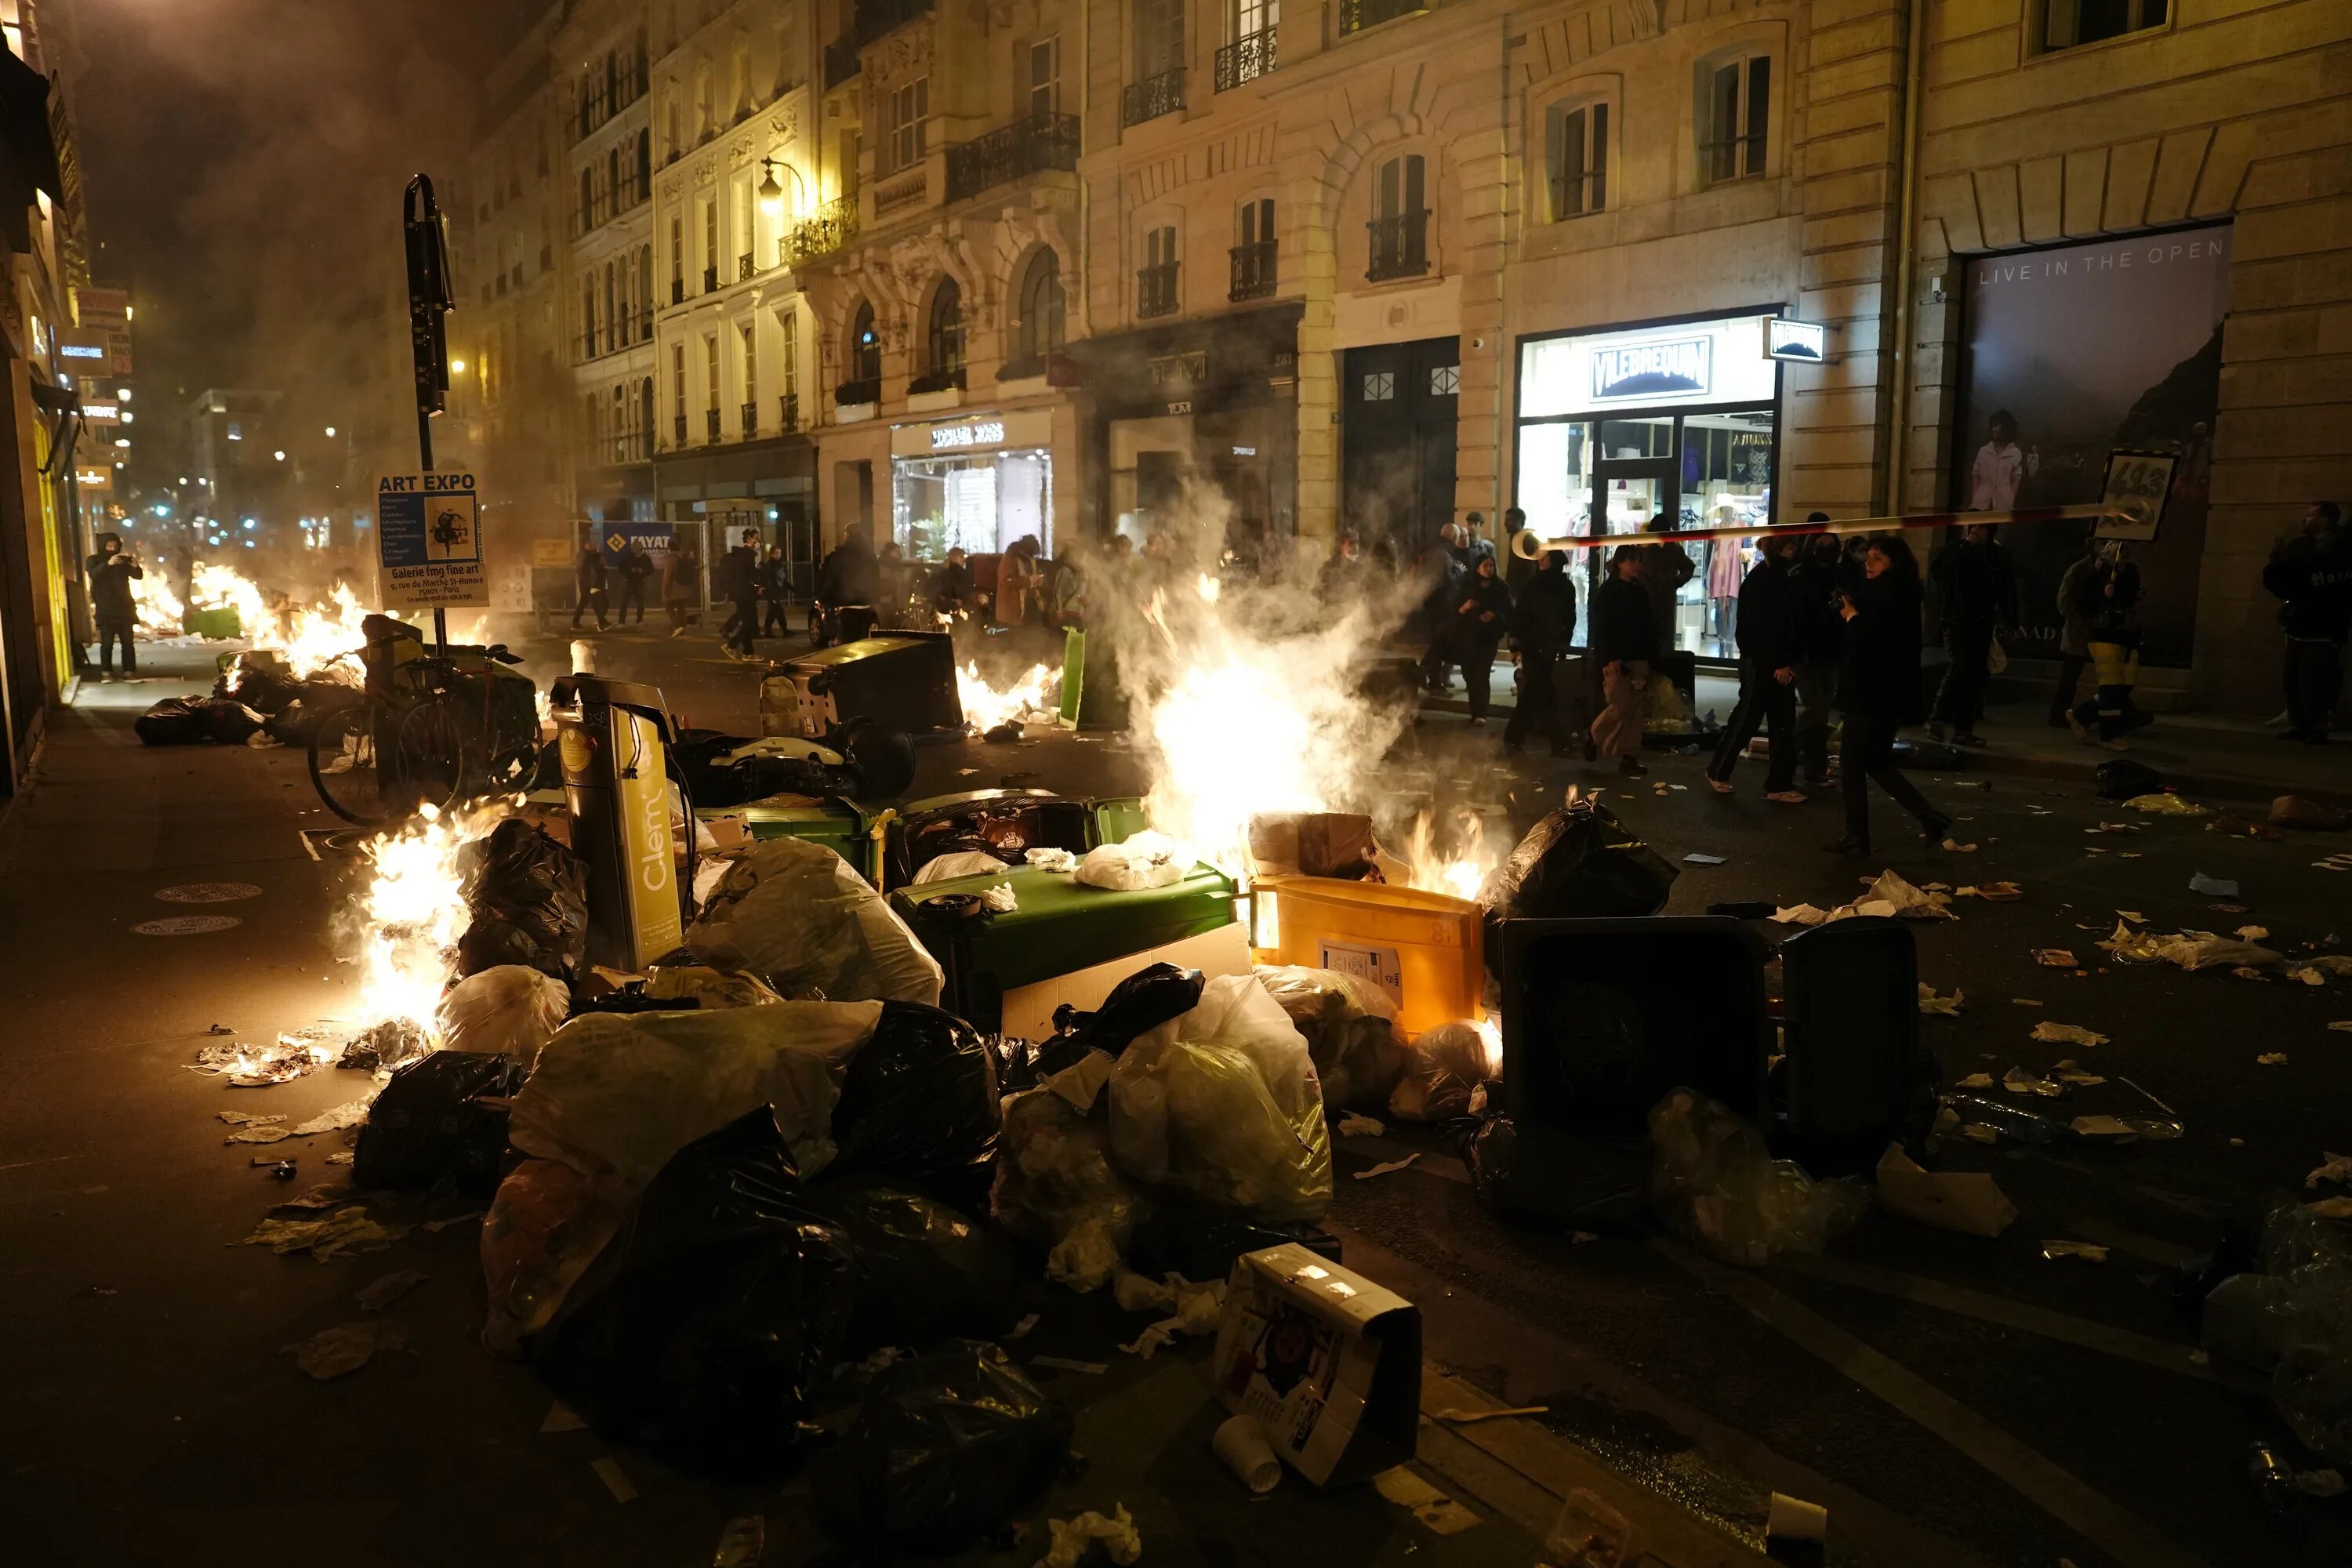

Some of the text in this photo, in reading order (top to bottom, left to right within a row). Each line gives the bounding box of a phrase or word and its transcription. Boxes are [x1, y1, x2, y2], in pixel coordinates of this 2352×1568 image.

[1980, 238, 2223, 285] LIVE IN THE OPEN
[1593, 340, 1706, 396] VILEBREQUIN
[379, 474, 475, 492] ART EXPO
[392, 566, 424, 579] Galerie
[446, 564, 464, 575] fine
[466, 564, 479, 575] art
[423, 579, 448, 587] Marché
[449, 576, 484, 586] St-Honoré
[418, 588, 437, 597] 75001
